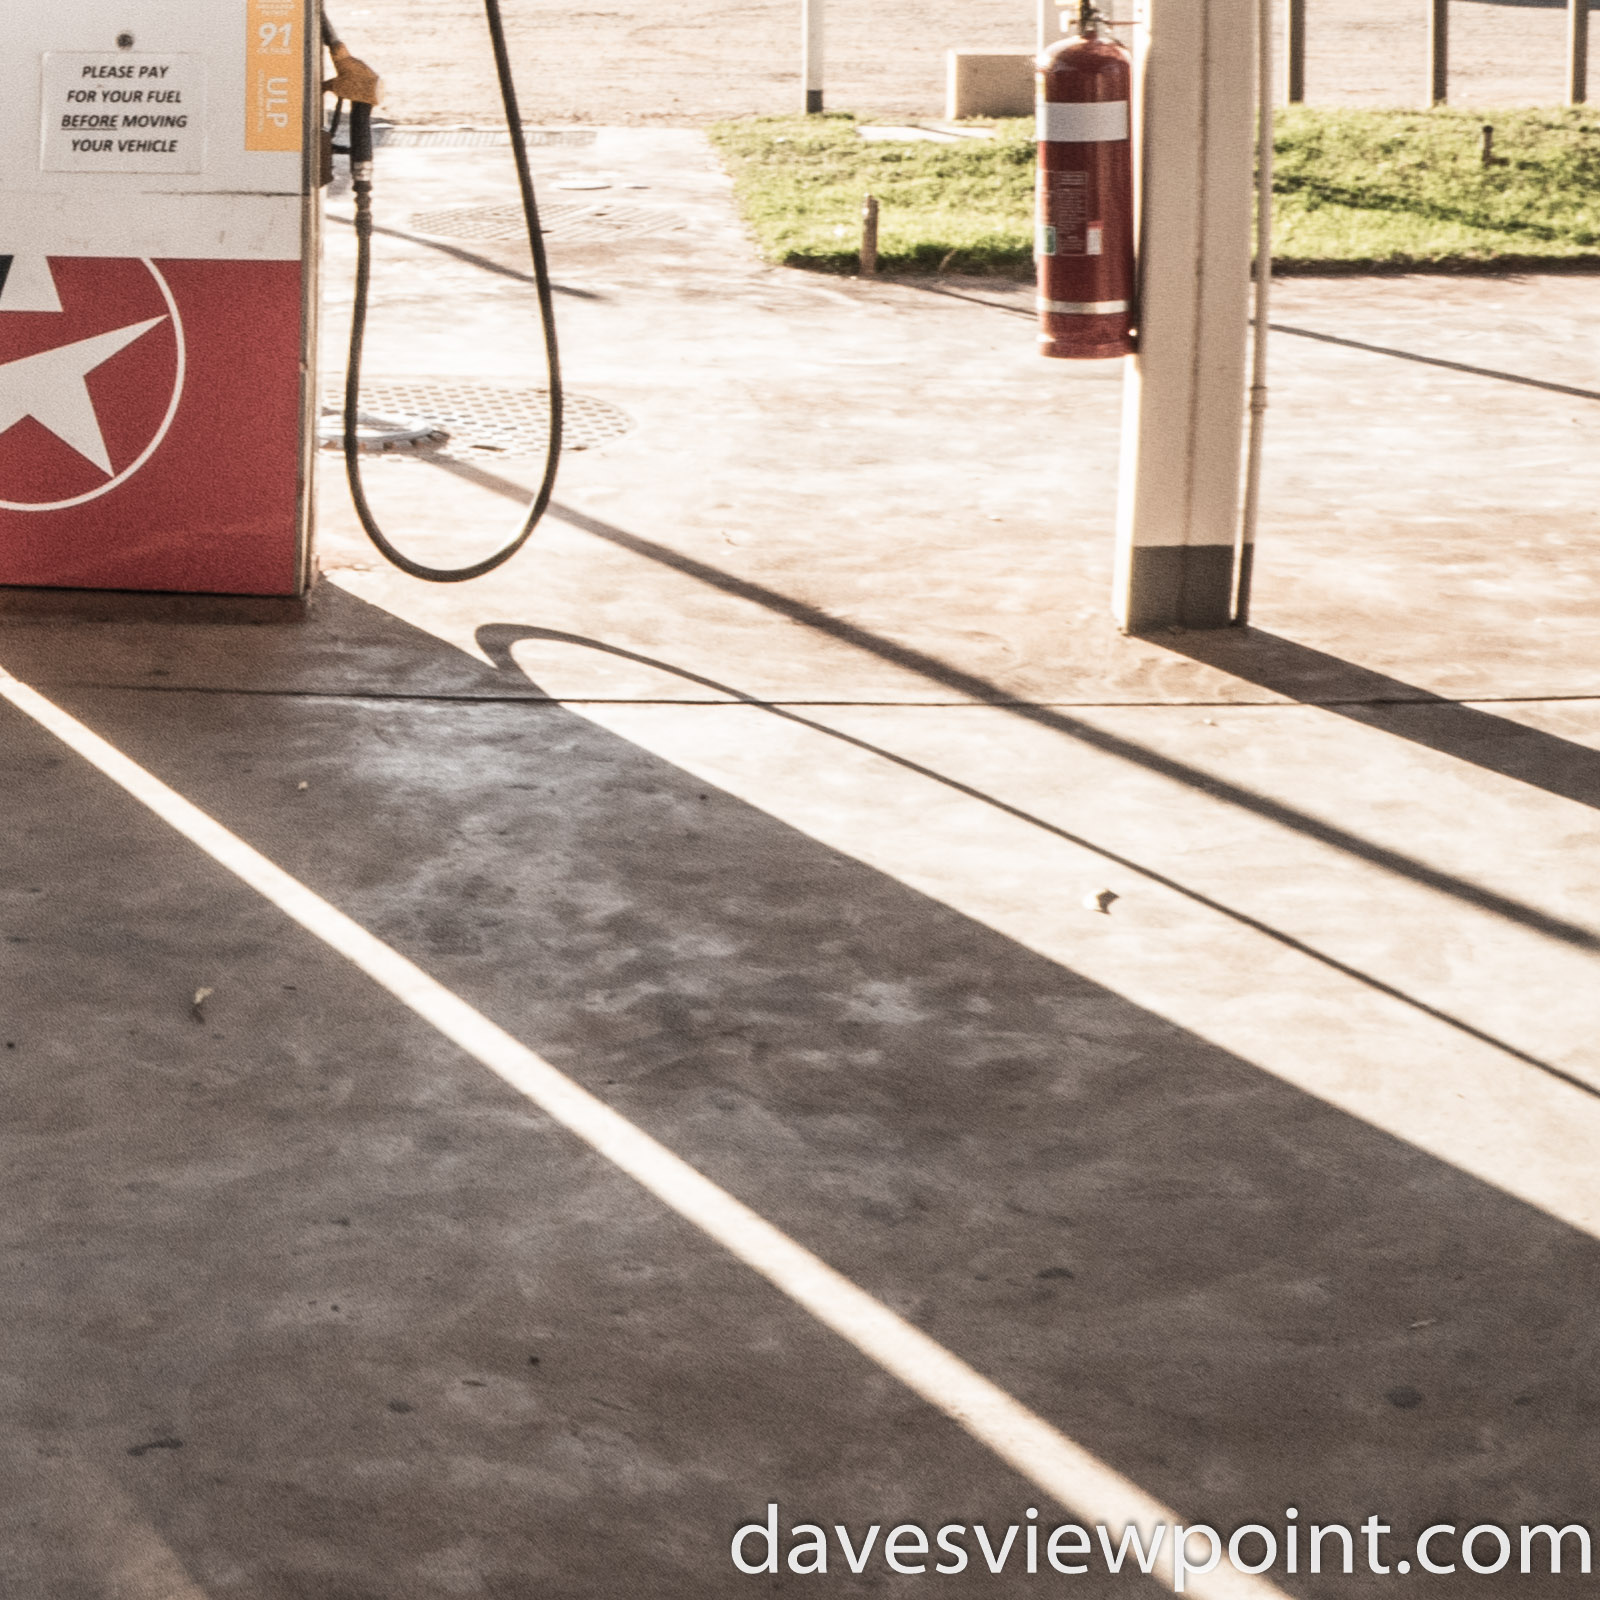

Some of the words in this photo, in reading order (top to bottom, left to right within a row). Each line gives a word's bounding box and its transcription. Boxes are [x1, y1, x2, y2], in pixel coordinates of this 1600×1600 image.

[258, 22, 292, 47] 91
[82, 65, 135, 78] PLEASE
[138, 65, 169, 78] PAY
[66, 90, 97, 103] FOR
[101, 90, 143, 103] YOUR
[146, 90, 182, 103] FUEL
[266, 76, 289, 129] ULP
[61, 114, 118, 129] BEFORE
[122, 115, 188, 128] MOVING
[72, 139, 114, 152] YOUR
[118, 139, 178, 152] VEHICLE
